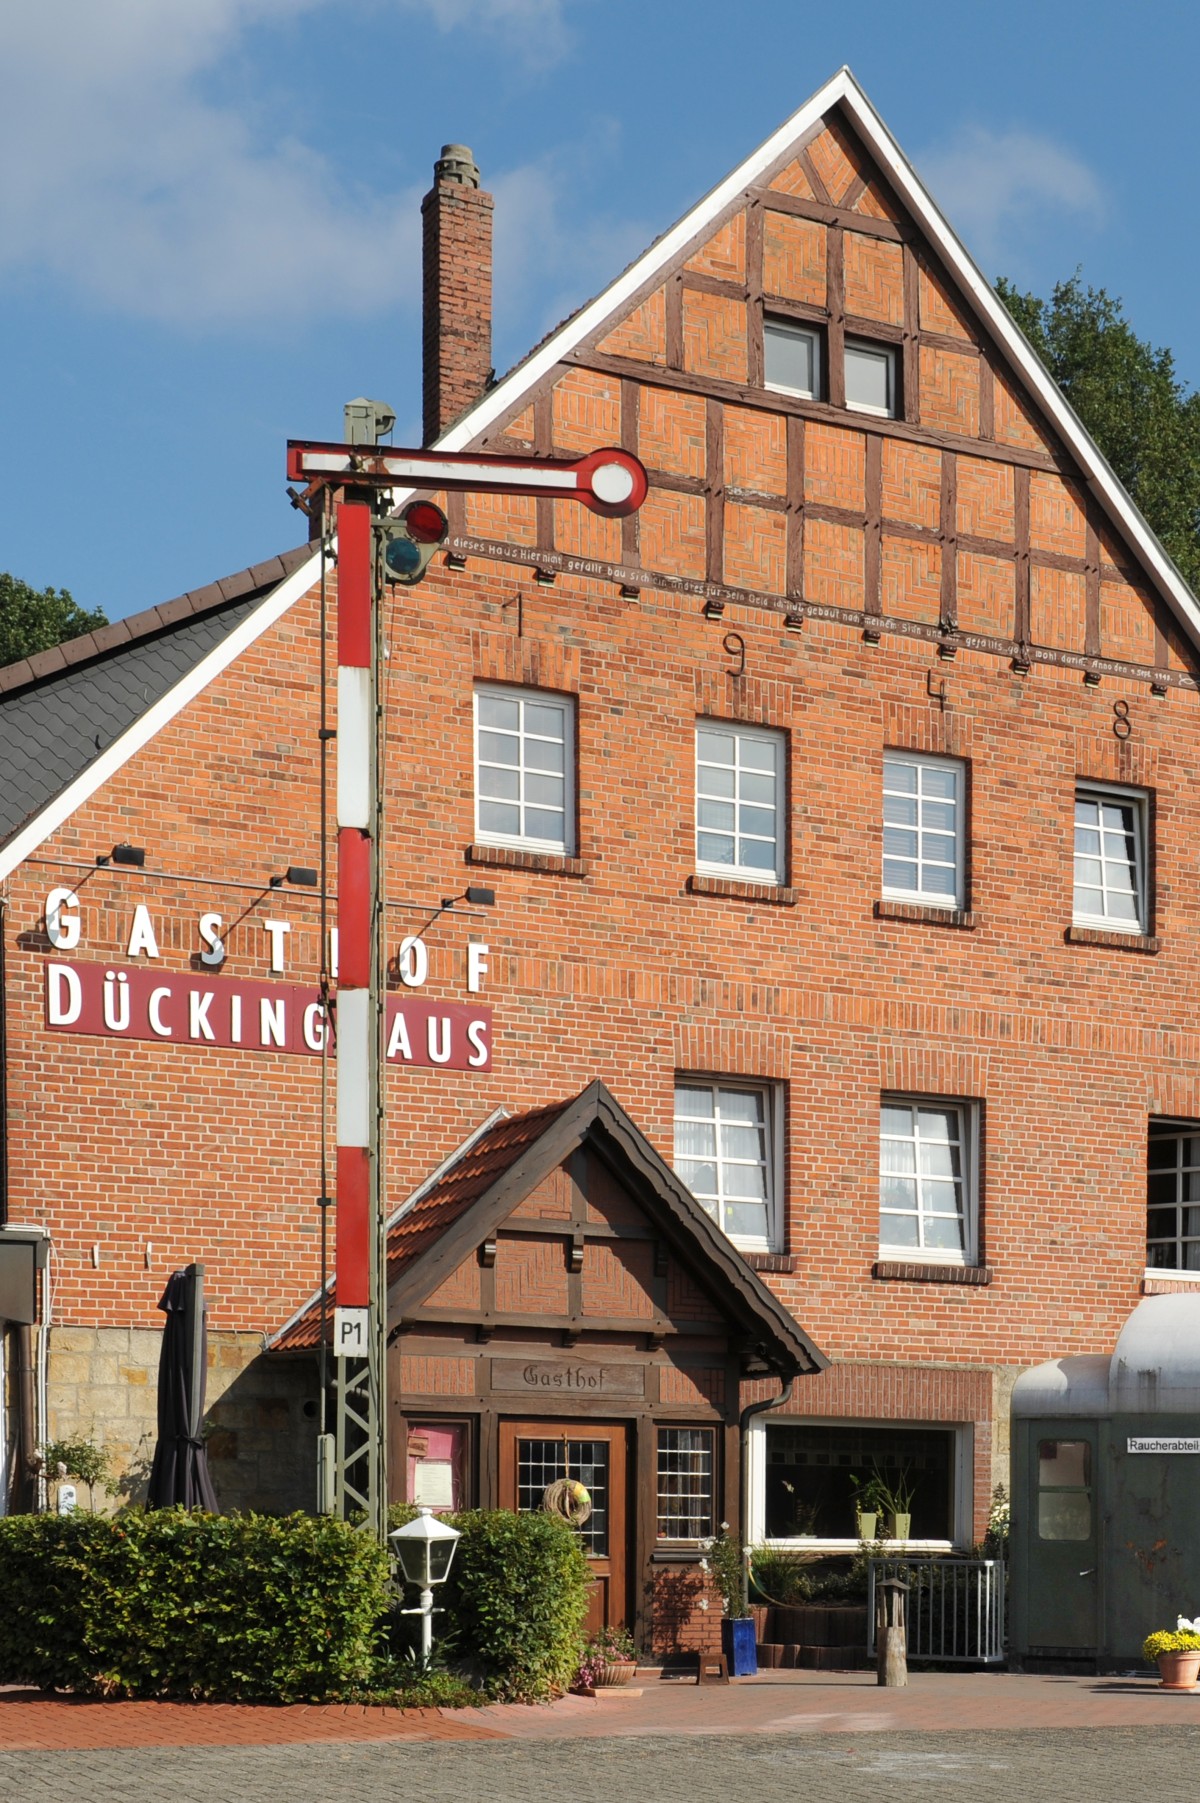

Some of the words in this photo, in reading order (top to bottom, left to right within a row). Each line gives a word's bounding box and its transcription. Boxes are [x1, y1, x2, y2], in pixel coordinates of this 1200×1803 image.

[453, 537, 485, 552] dieses
[488, 545, 518, 558] Haus
[520, 549, 541, 561] Hier
[607, 566, 626, 578] bau
[630, 570, 650, 583] sich
[706, 585, 720, 597] für
[807, 606, 840, 617] gebaut
[1091, 660, 1113, 670] Anno
[1113, 663, 1128, 673] den
[48, 964, 488, 1067] DÜCKINGAUS
[341, 1322, 362, 1345] P1
[523, 1364, 610, 1390] Gasthof
[1130, 1440, 1199, 1451] Raucherabteil
